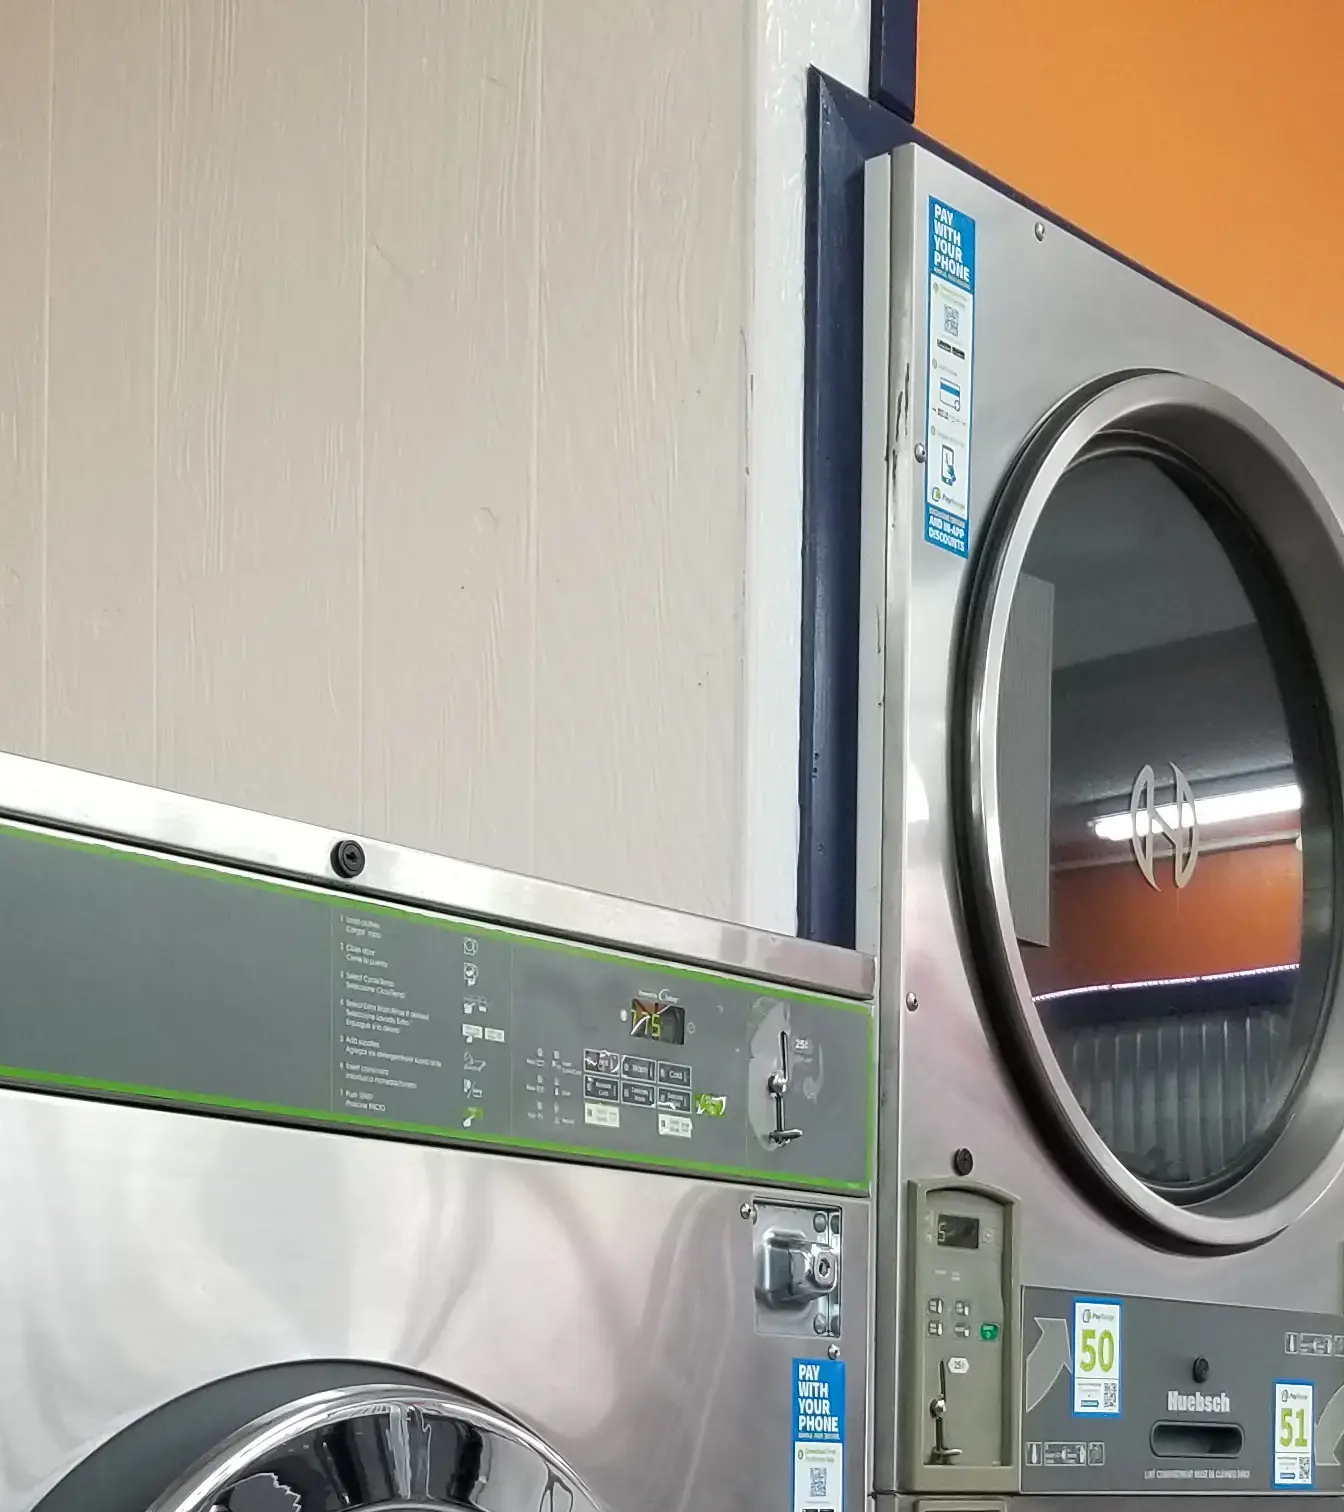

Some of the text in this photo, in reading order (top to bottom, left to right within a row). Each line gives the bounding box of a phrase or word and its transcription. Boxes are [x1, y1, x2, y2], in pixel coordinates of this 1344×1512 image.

[934, 203, 954, 226] PAY
[934, 219, 962, 246] WITH
[934, 234, 963, 264] YOUR
[934, 250, 971, 284] PHONE
[1079, 1328, 1115, 1374] 50
[798, 1363, 821, 1381] PAY
[798, 1381, 829, 1399] WITH
[1167, 1389, 1232, 1414] Huebsch
[798, 1397, 831, 1415] YOUR
[798, 1415, 839, 1433] PHONE
[1279, 1408, 1308, 1448] 51
